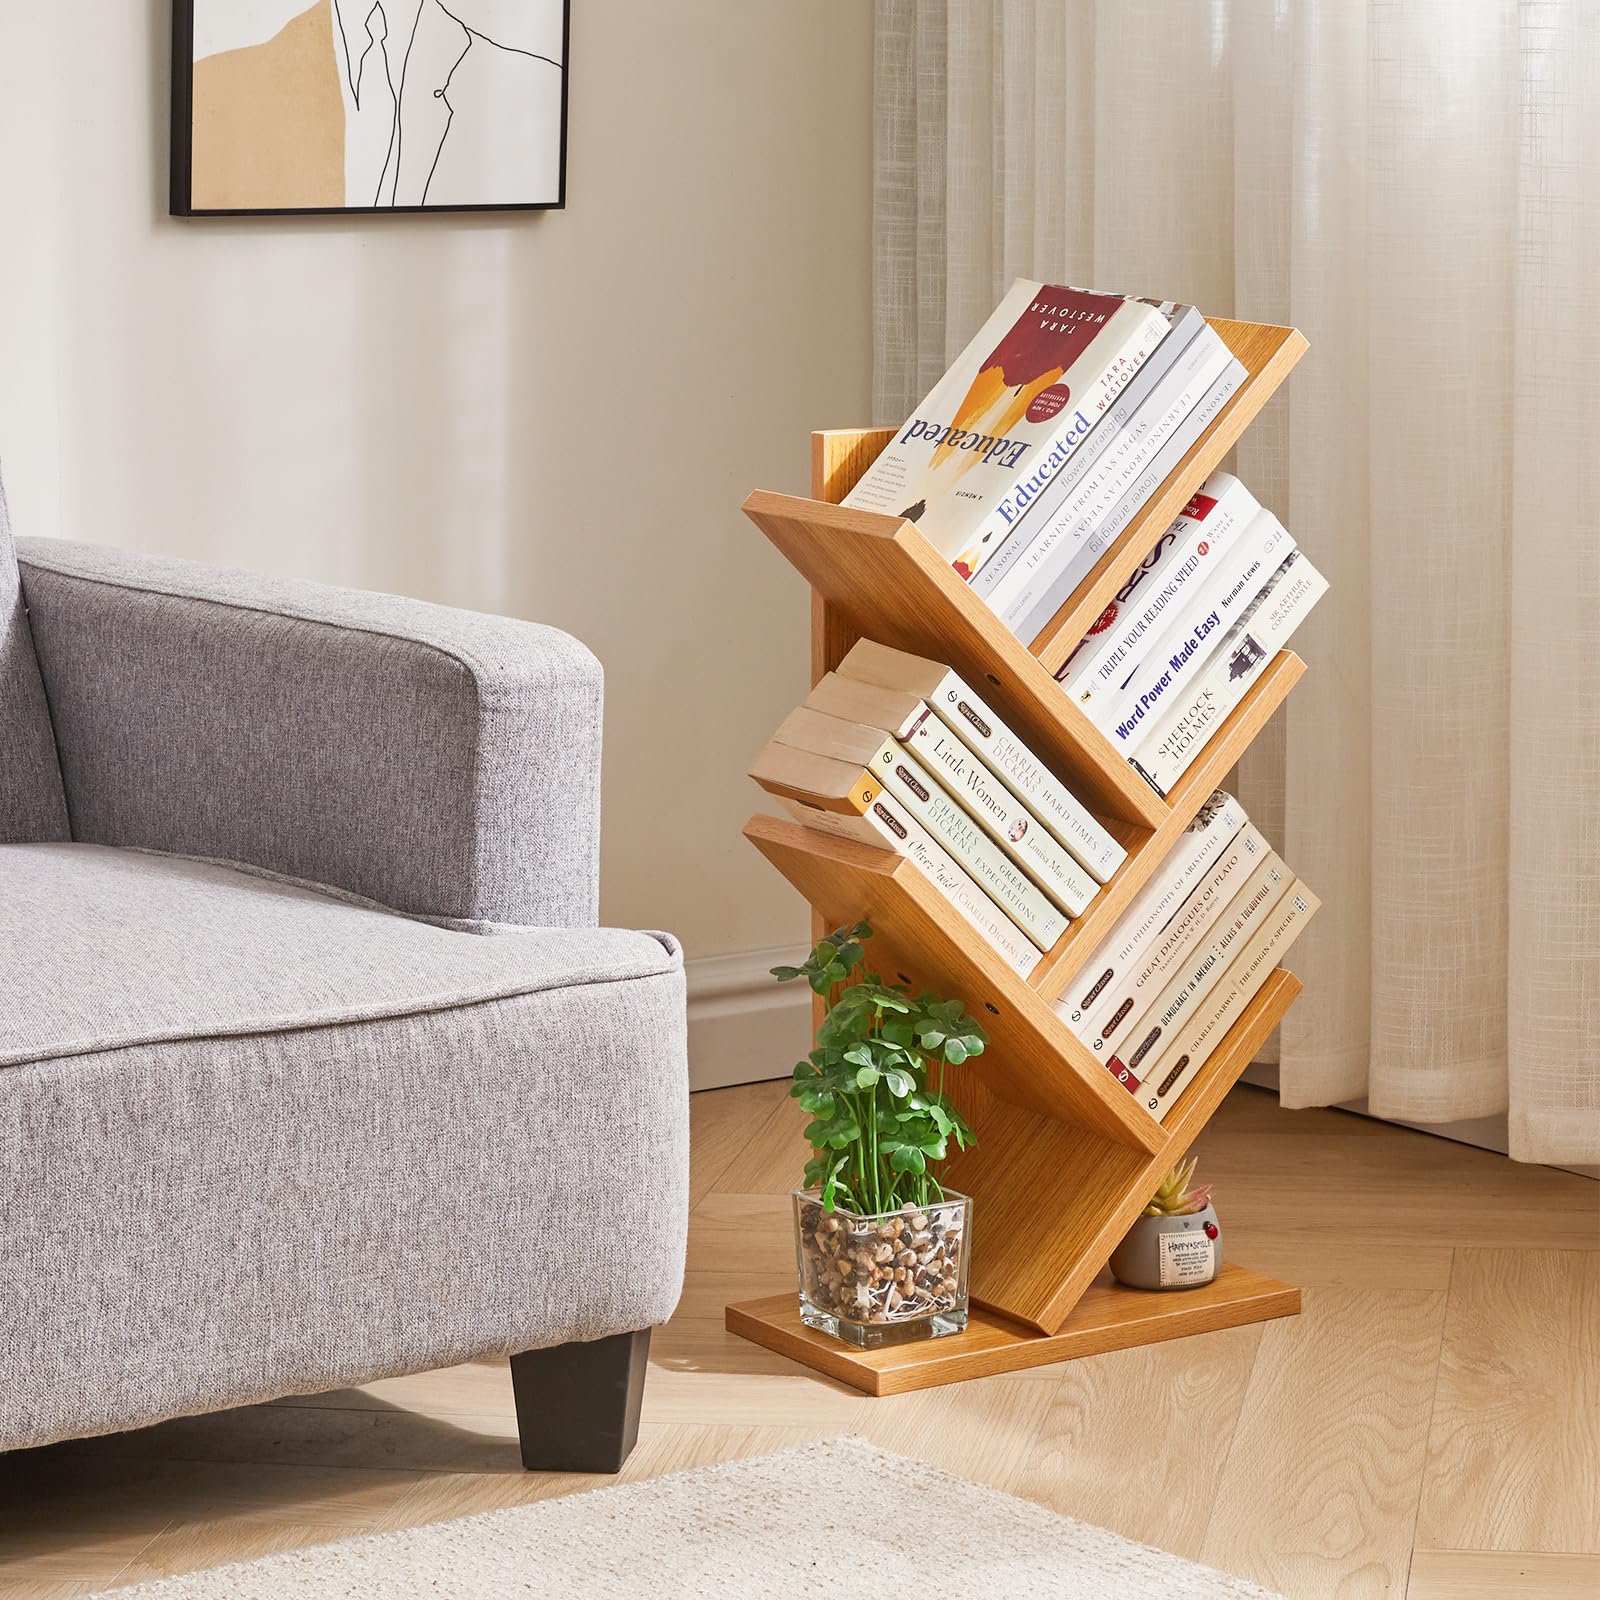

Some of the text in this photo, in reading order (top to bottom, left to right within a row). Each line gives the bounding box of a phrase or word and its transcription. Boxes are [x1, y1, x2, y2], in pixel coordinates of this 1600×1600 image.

[1031, 302, 1106, 324] WESTOVER
[1039, 320, 1076, 334] TARA
[1096, 350, 1146, 411] WESTOVER
[1100, 358, 1126, 387] TARA
[1196, 380, 1233, 423] SEASONAL
[900, 419, 1032, 469] Educated
[996, 411, 1092, 527] Educated
[1061, 407, 1128, 488] flower arranging
[1073, 393, 1192, 539] LEARNING FROM LAS VEGAS
[1026, 421, 1148, 569] LEARNING FROM LAS VEGAS
[1089, 474, 1158, 553] flower arranging
[985, 539, 1021, 585] SEASONAL
[1221, 560, 1261, 609] Norman Lewis
[1098, 647, 1128, 680] TRIPLE
[1123, 620, 1149, 650] YOUR
[1144, 582, 1179, 624] READING
[1174, 555, 1200, 591] SPEED
[1269, 578, 1304, 621] SIR ARTHUR
[1271, 579, 1313, 631] CONAN DOYLE
[1115, 610, 1221, 741] Word Power Made Easy
[1158, 687, 1214, 759] SHERLOCK
[1171, 703, 1216, 760] HOLMES
[933, 739, 1007, 821] Little Women
[992, 745, 1038, 793] DICKENS
[998, 737, 1044, 785] CHARLES
[928, 806, 973, 855] DICKENS
[934, 798, 979, 847] CHARLES
[1043, 790, 1099, 850] HARD TIMES
[975, 857, 1036, 922] EXPECTATIONS
[999, 864, 1028, 895] GREAT
[1027, 837, 1085, 901] Louisa May Alcott
[1119, 835, 1219, 960] THE PHILOSOPHY OF ARISTOTLE
[1136, 956, 1161, 988] GREAT
[1160, 901, 1204, 956] DIALOGUES
[1202, 886, 1214, 901] OF
[1214, 855, 1239, 887] PLATO
[1095, 970, 1113, 993] Classics
[1160, 884, 1270, 1026] DEMOCRACY IN AMERICA ALEXIS DE TOCQUEVILLE
[1190, 911, 1296, 1053] CHARLES DARWIN THE ORIGIN of SPECIES
[1115, 999, 1133, 1022] Classics
